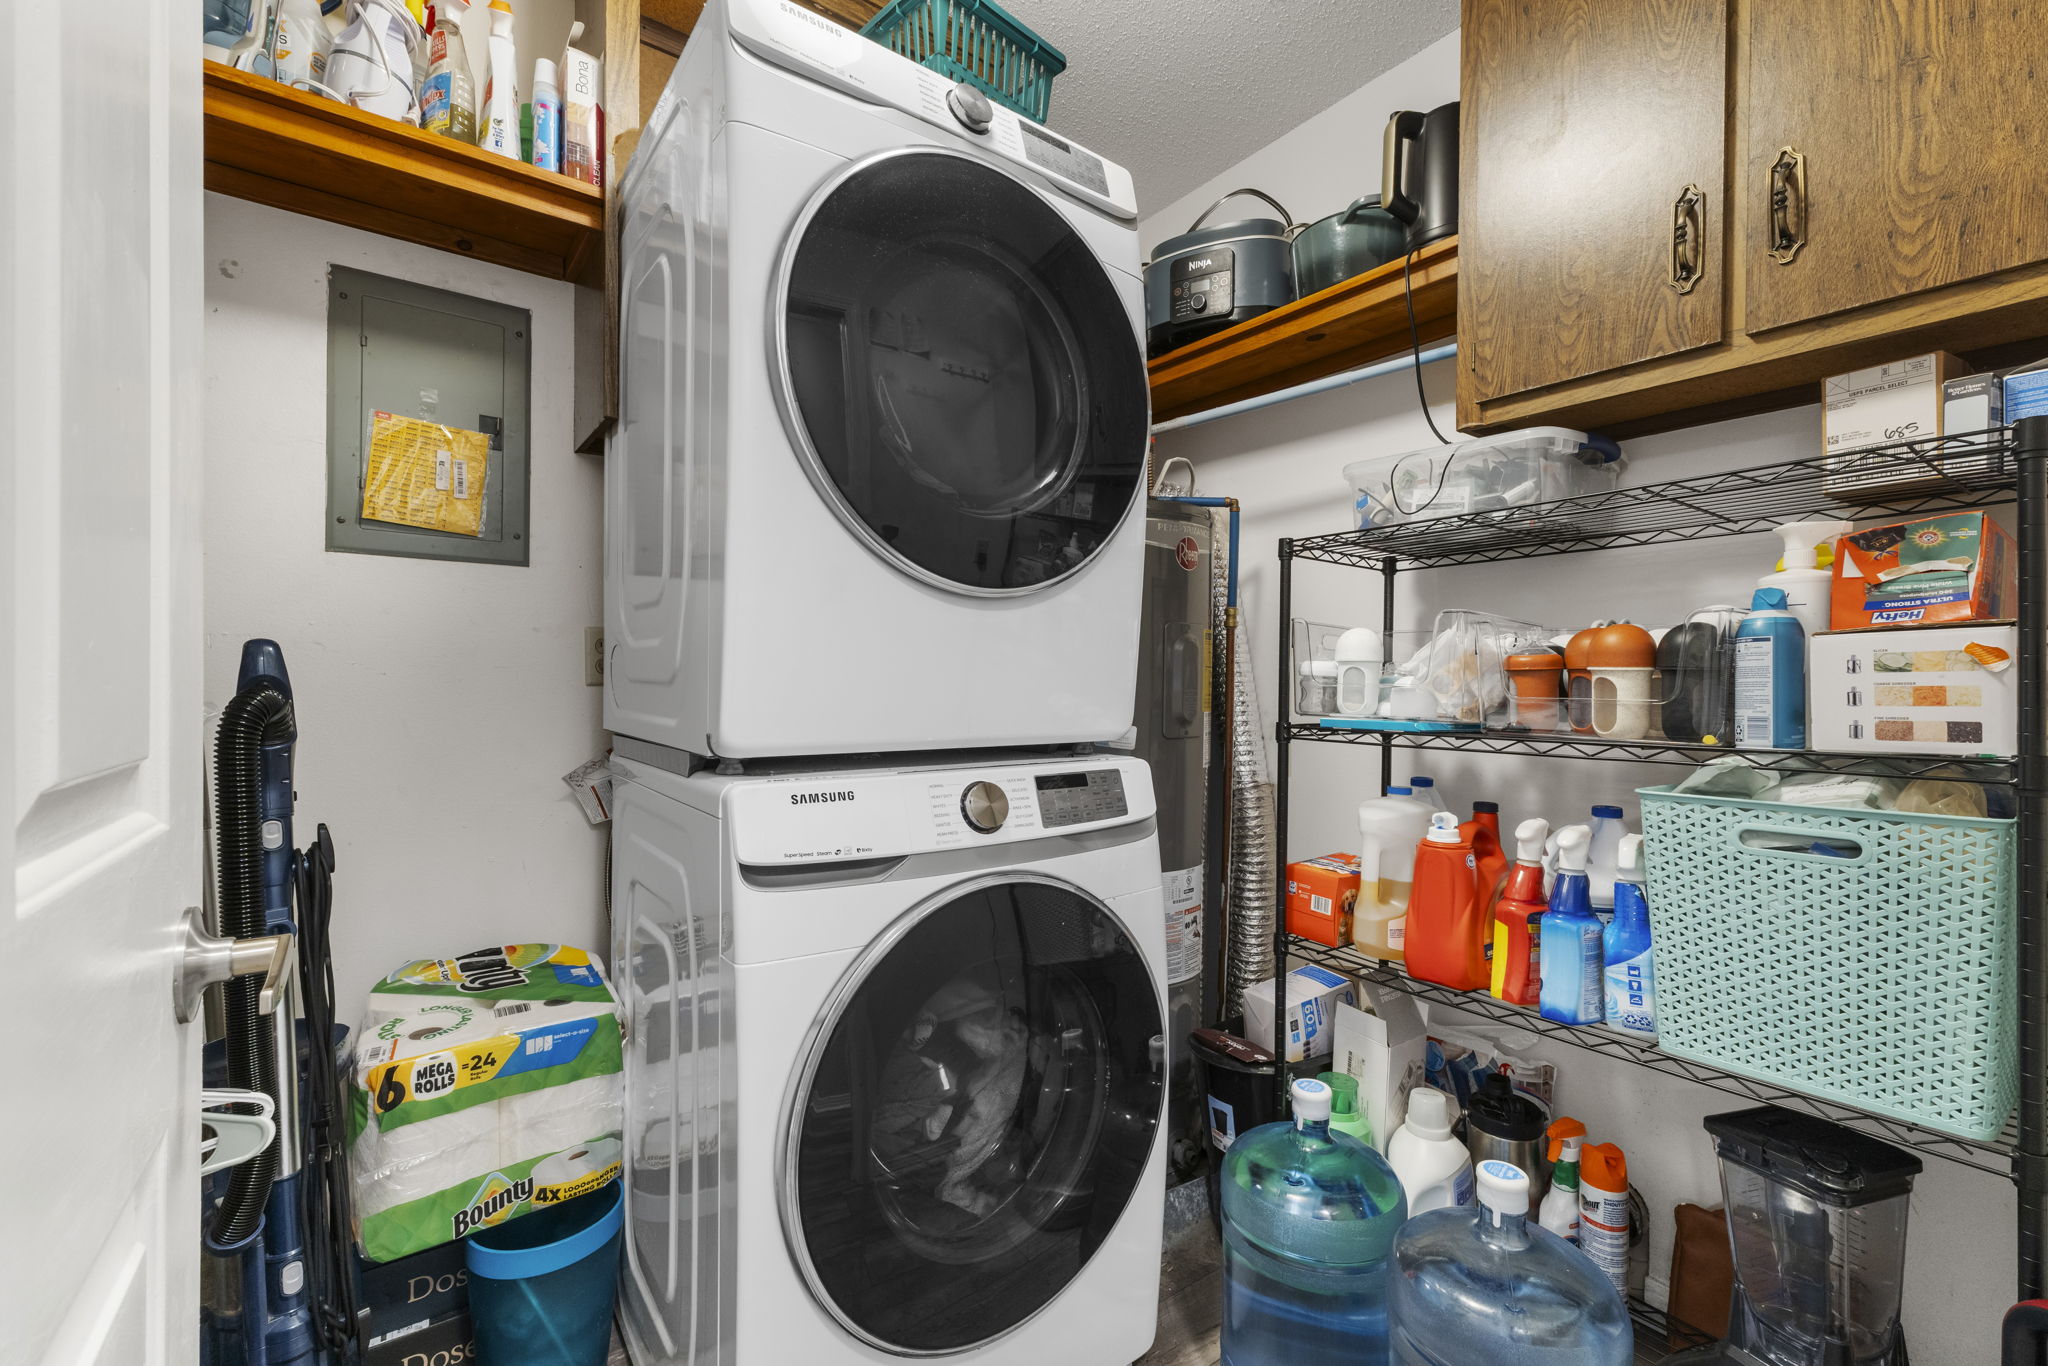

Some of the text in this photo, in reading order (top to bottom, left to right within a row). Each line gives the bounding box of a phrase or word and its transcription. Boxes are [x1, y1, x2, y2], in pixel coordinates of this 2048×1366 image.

[780, 2, 842, 38] SAMSUNG
[575, 60, 589, 95] Bona
[1188, 258, 1212, 271] NINJA
[1864, 385, 1886, 394] PARCEL
[1887, 380, 1909, 390] SELECT
[1884, 422, 1919, 439] 685
[1923, 596, 1954, 605] ULTRA
[1875, 610, 1921, 622] Hefty
[790, 790, 855, 805] SAMSUNG
[1304, 1003, 1315, 1025] 60
[553, 1027, 590, 1040] select-a-size
[416, 1062, 454, 1082] MEGA
[470, 1069, 488, 1077] Regular
[376, 1065, 406, 1113] 6
[414, 1074, 456, 1094] ROLLS
[563, 1184, 595, 1200] LASTING
[453, 1176, 534, 1240] Bounty
[407, 1267, 469, 1304] Dos
